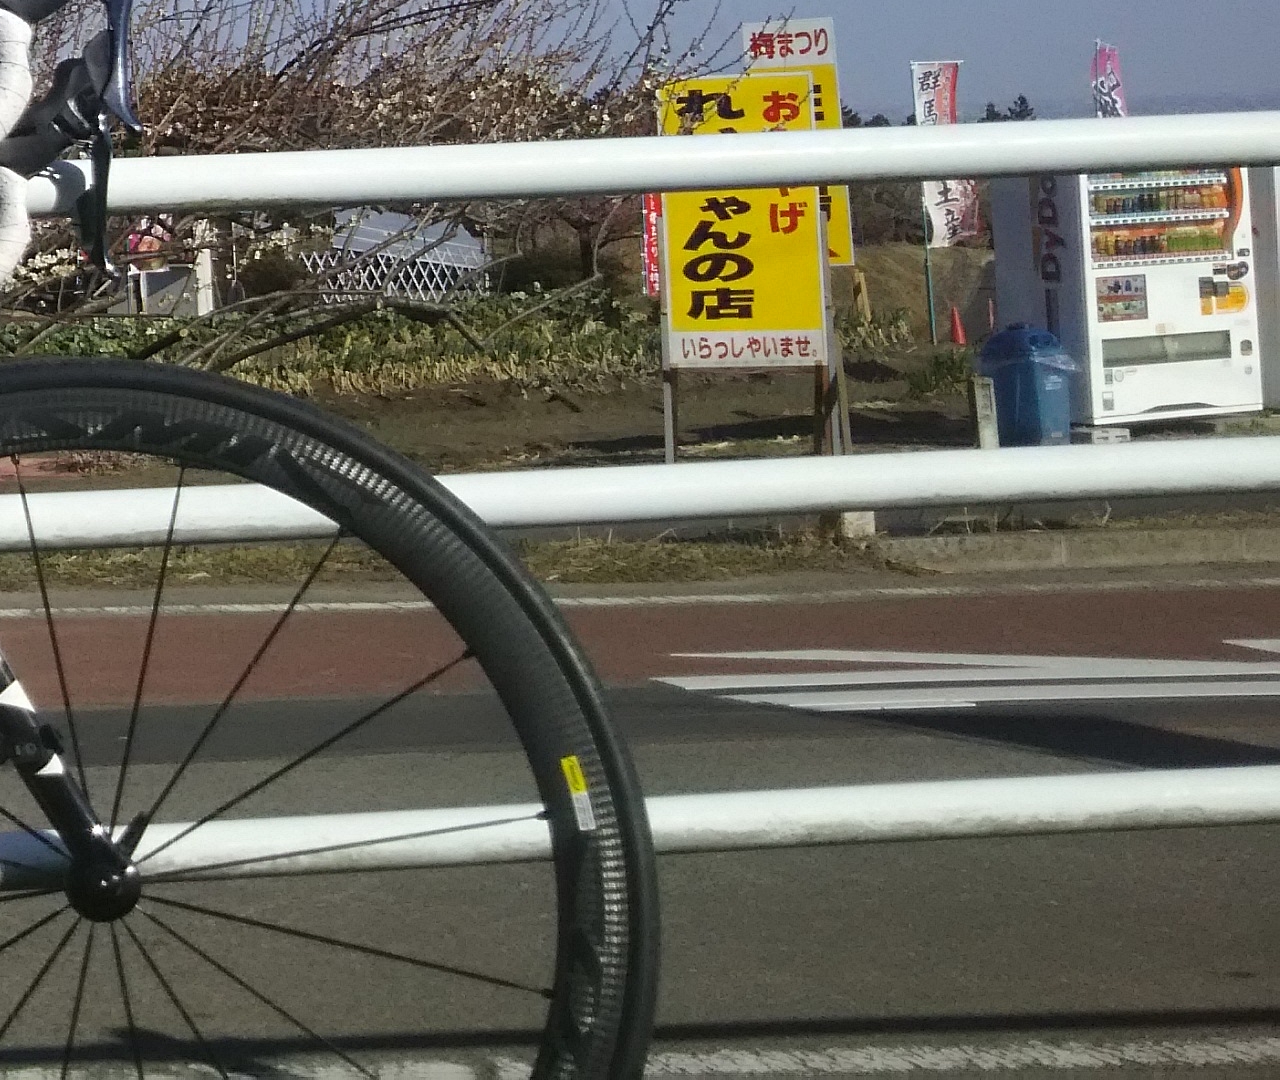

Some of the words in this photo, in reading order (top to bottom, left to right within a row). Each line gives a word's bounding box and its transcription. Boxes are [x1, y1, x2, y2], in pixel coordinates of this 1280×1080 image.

[748, 27, 829, 60] 梅まつり
[761, 90, 808, 235] おげ
[917, 67, 963, 241] 群馬土産
